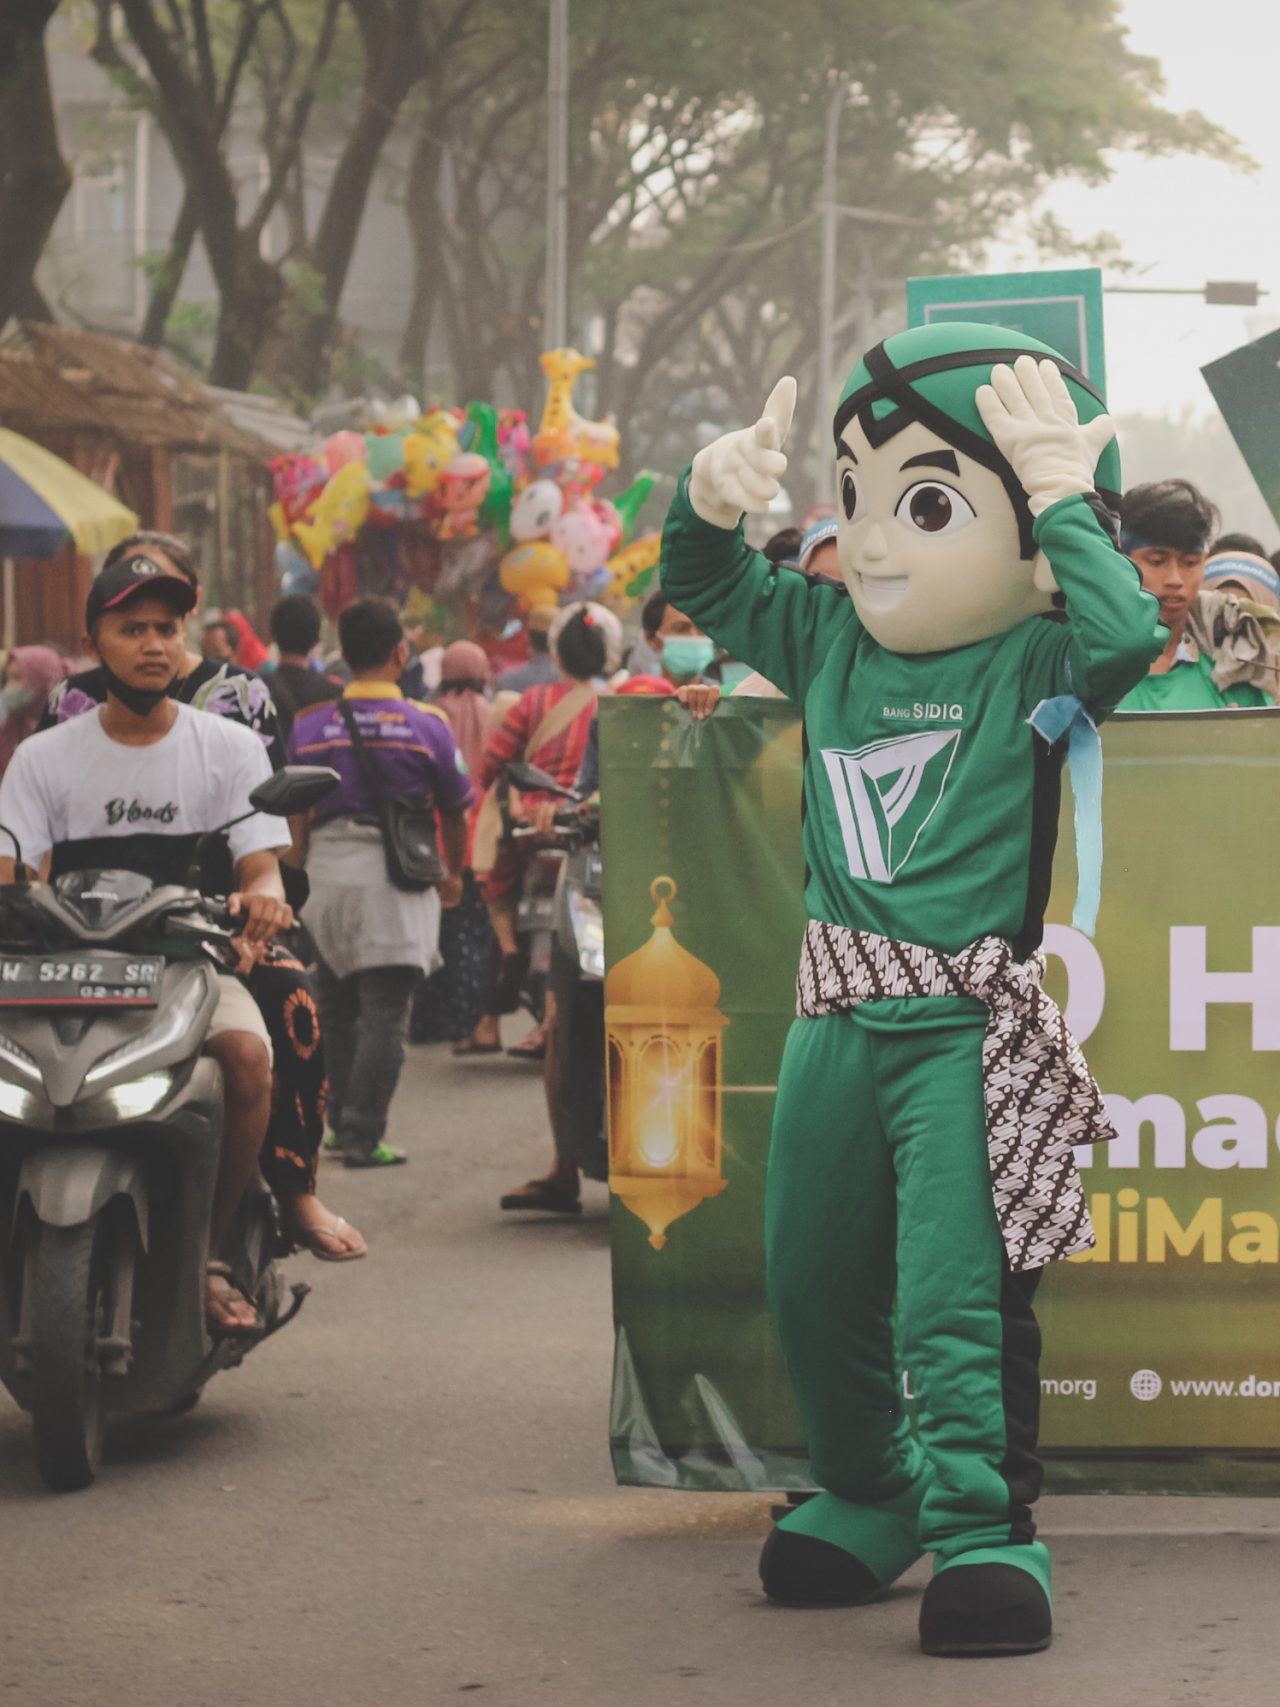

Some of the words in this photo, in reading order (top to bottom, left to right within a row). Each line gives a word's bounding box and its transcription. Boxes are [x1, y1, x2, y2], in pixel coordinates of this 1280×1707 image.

[883, 707, 911, 719] BANG
[913, 703, 963, 721] SIDIQ
[39, 962, 104, 982] 5262
